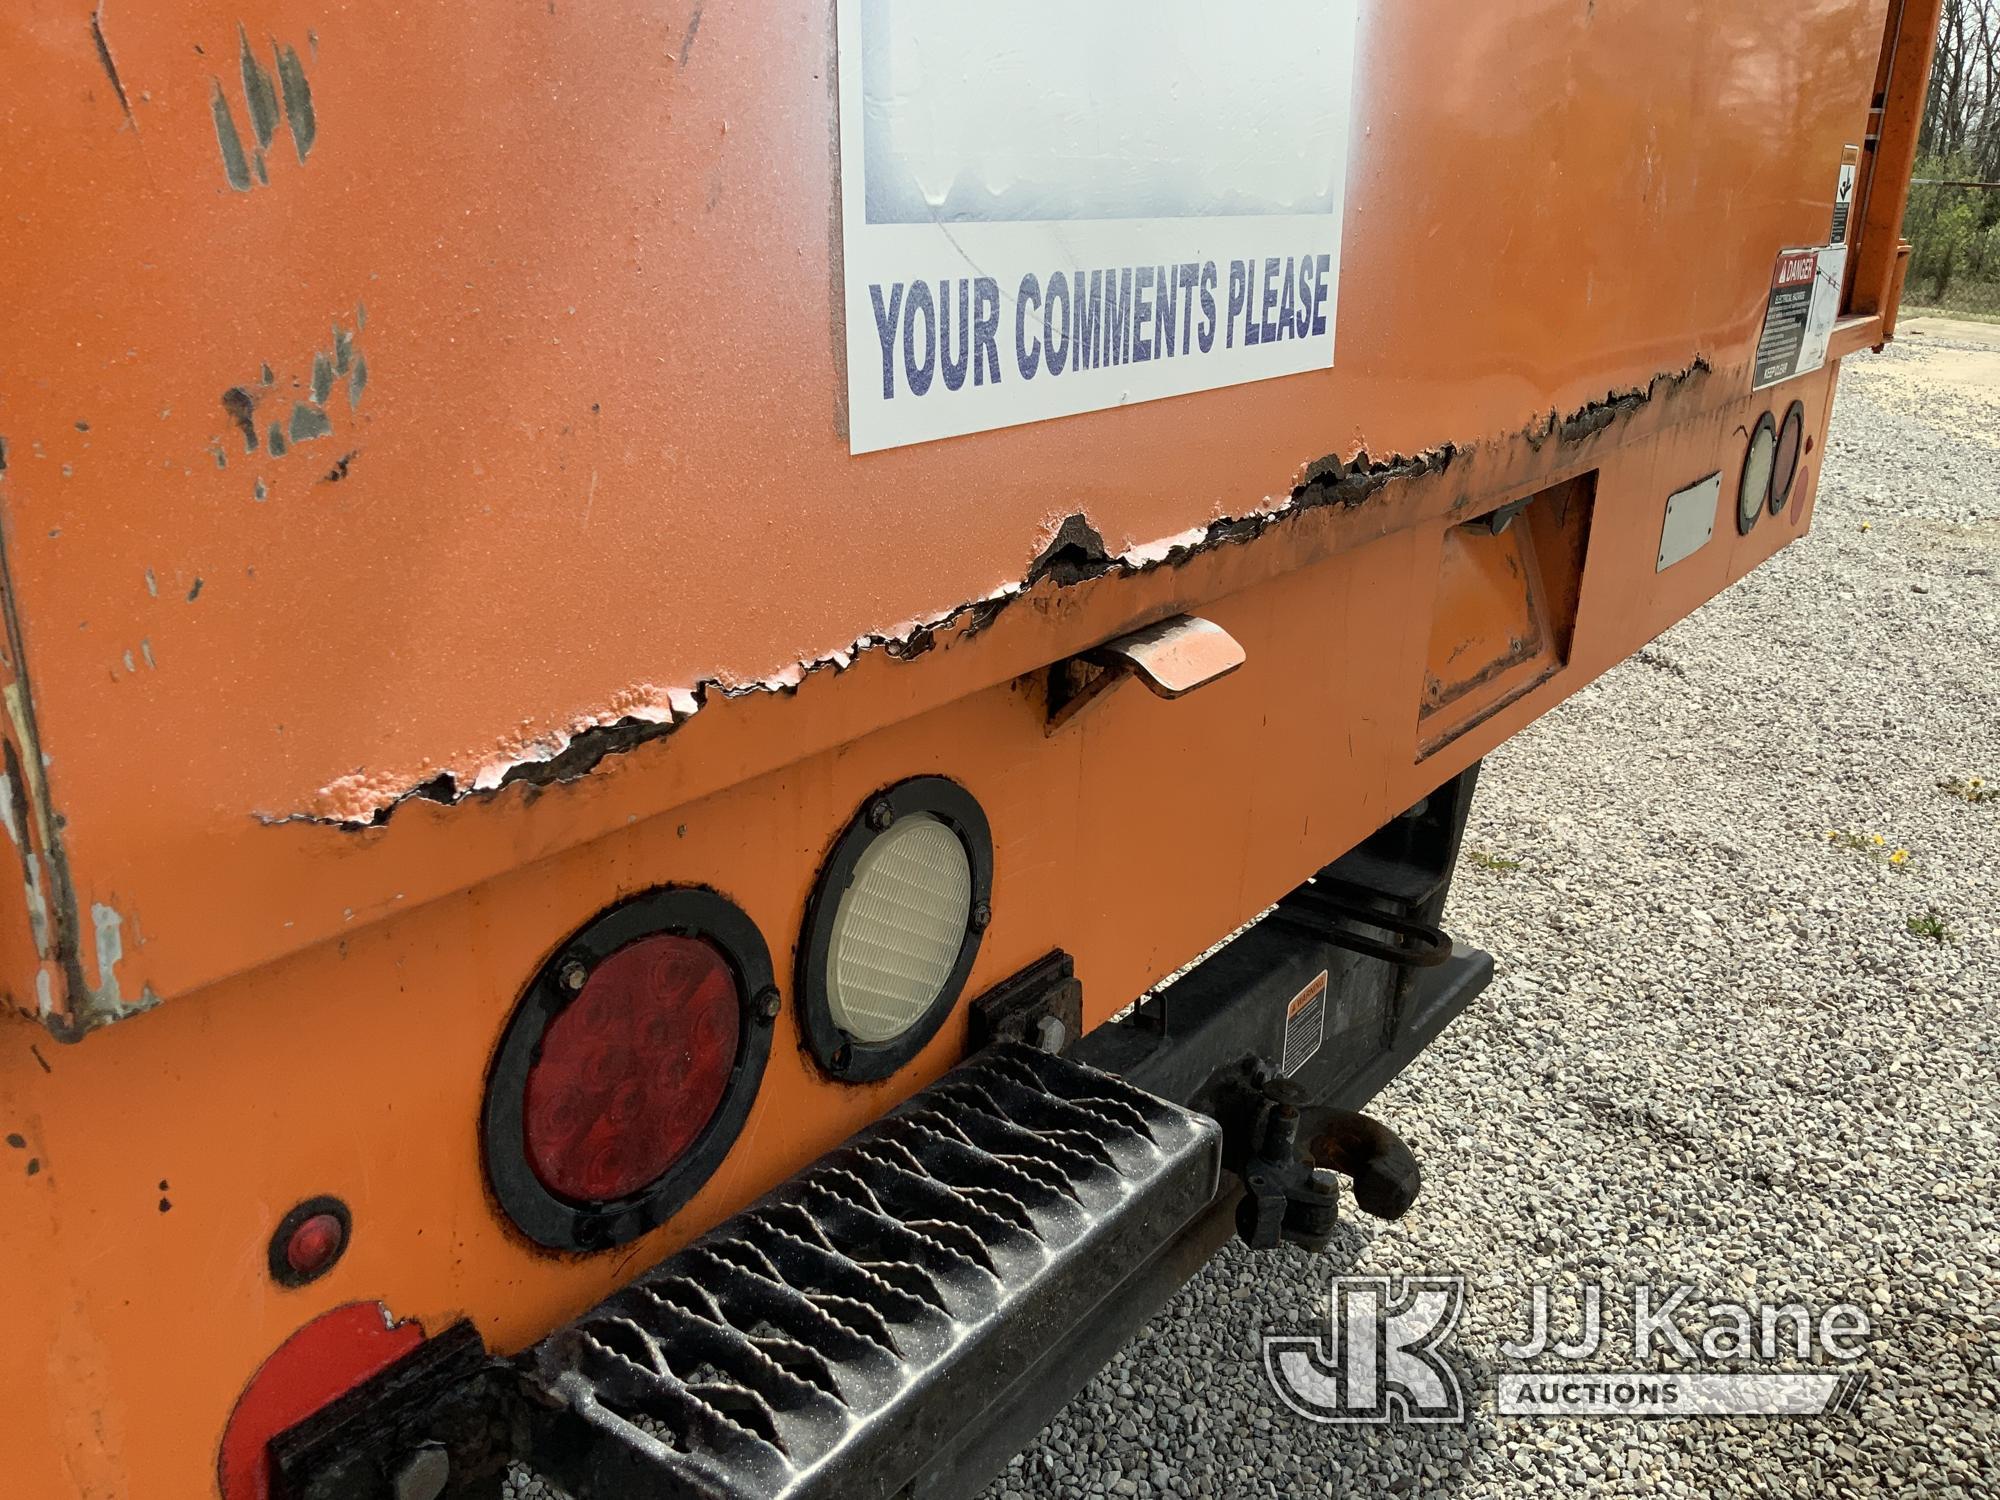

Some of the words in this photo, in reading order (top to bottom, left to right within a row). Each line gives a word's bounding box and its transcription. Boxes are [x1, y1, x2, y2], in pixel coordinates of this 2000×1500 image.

[1786, 258, 1814, 282] DANGER
[868, 276, 1002, 399] YOUR
[1016, 260, 1217, 380] COMMENTS
[1226, 254, 1331, 348] PLEASE
[1297, 976, 1324, 1006] WARNING
